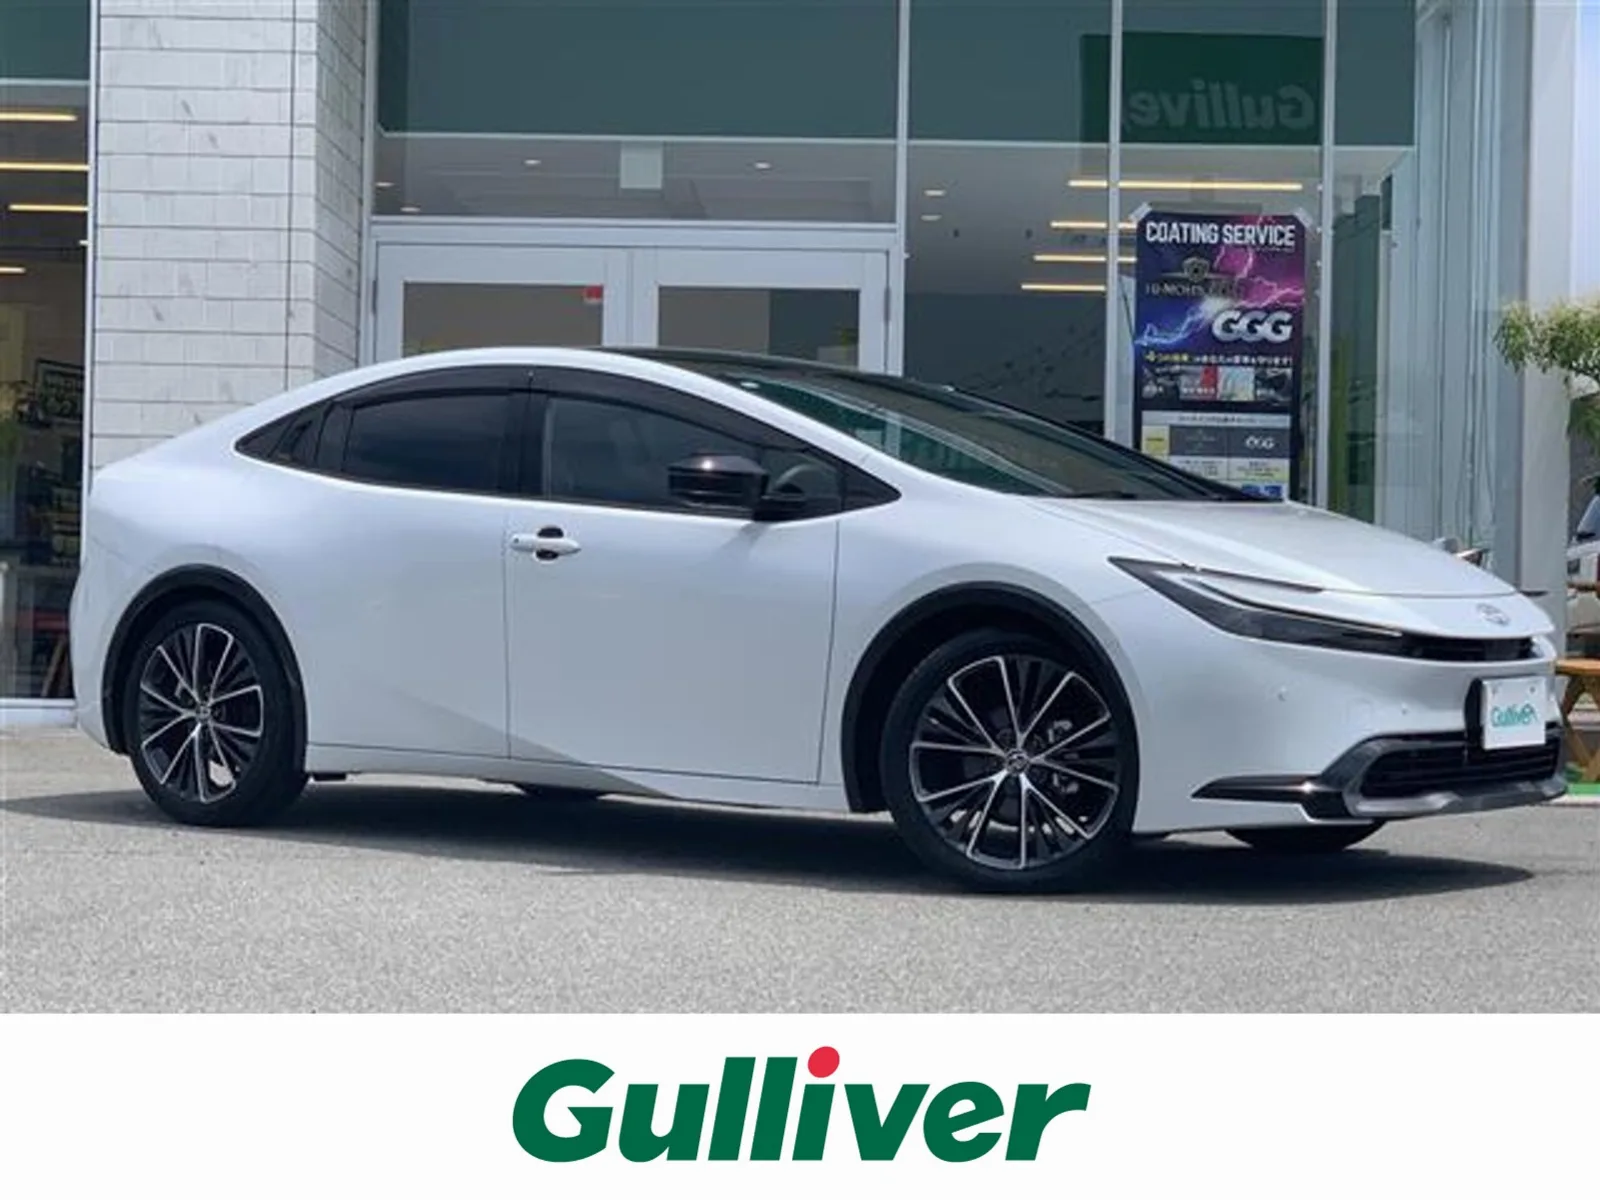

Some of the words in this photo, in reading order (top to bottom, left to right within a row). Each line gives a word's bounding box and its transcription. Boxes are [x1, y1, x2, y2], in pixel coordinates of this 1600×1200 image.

[1145, 221, 1219, 244] COATING
[1222, 223, 1296, 246] SERVICE
[1212, 310, 1293, 342] GGG
[1490, 703, 1539, 728] Gulliver
